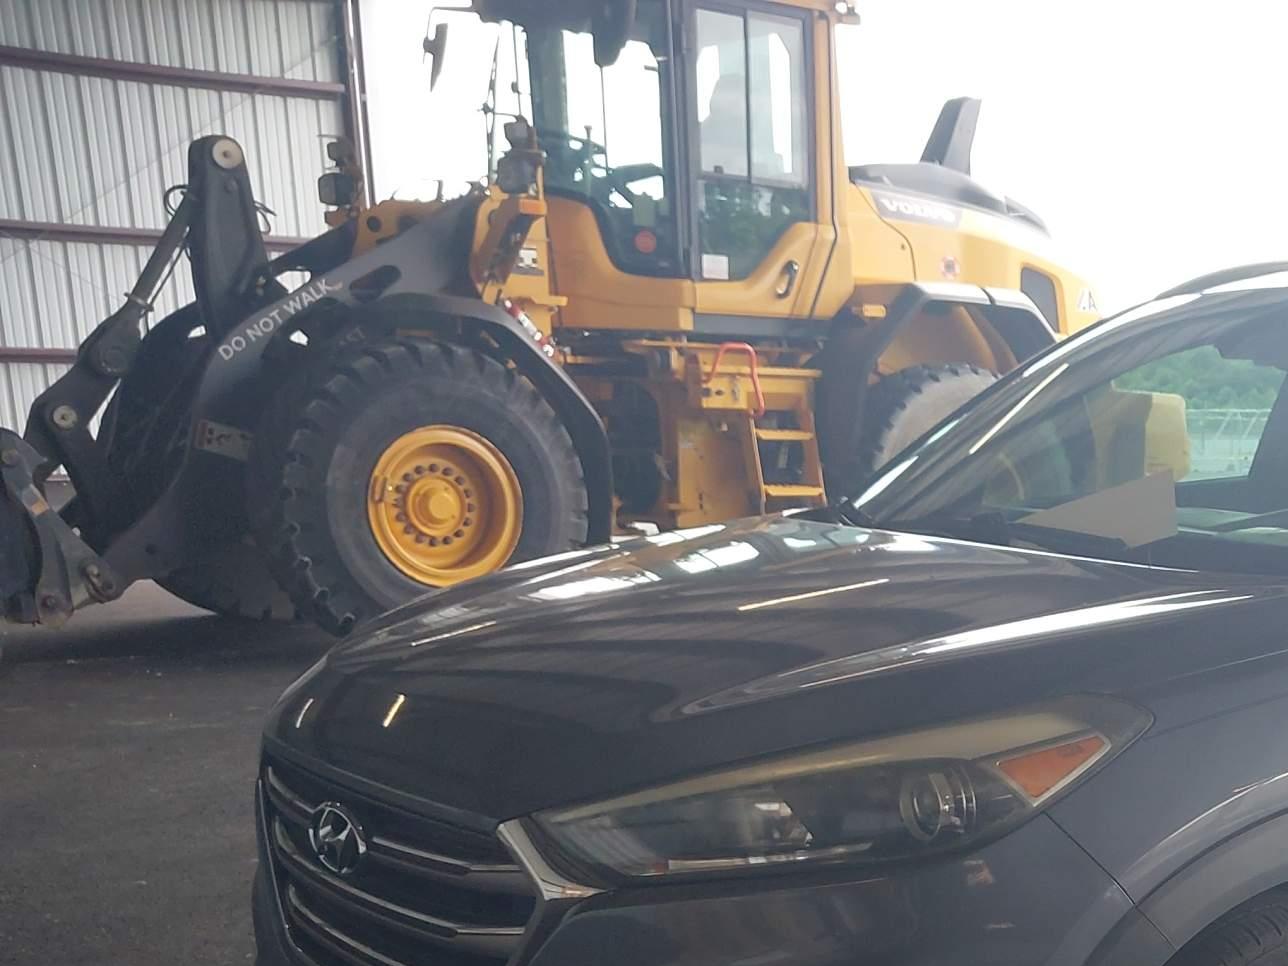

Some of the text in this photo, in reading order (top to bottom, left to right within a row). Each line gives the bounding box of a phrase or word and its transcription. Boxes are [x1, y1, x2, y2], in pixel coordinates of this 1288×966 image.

[218, 279, 334, 361] DO NOT WALK
